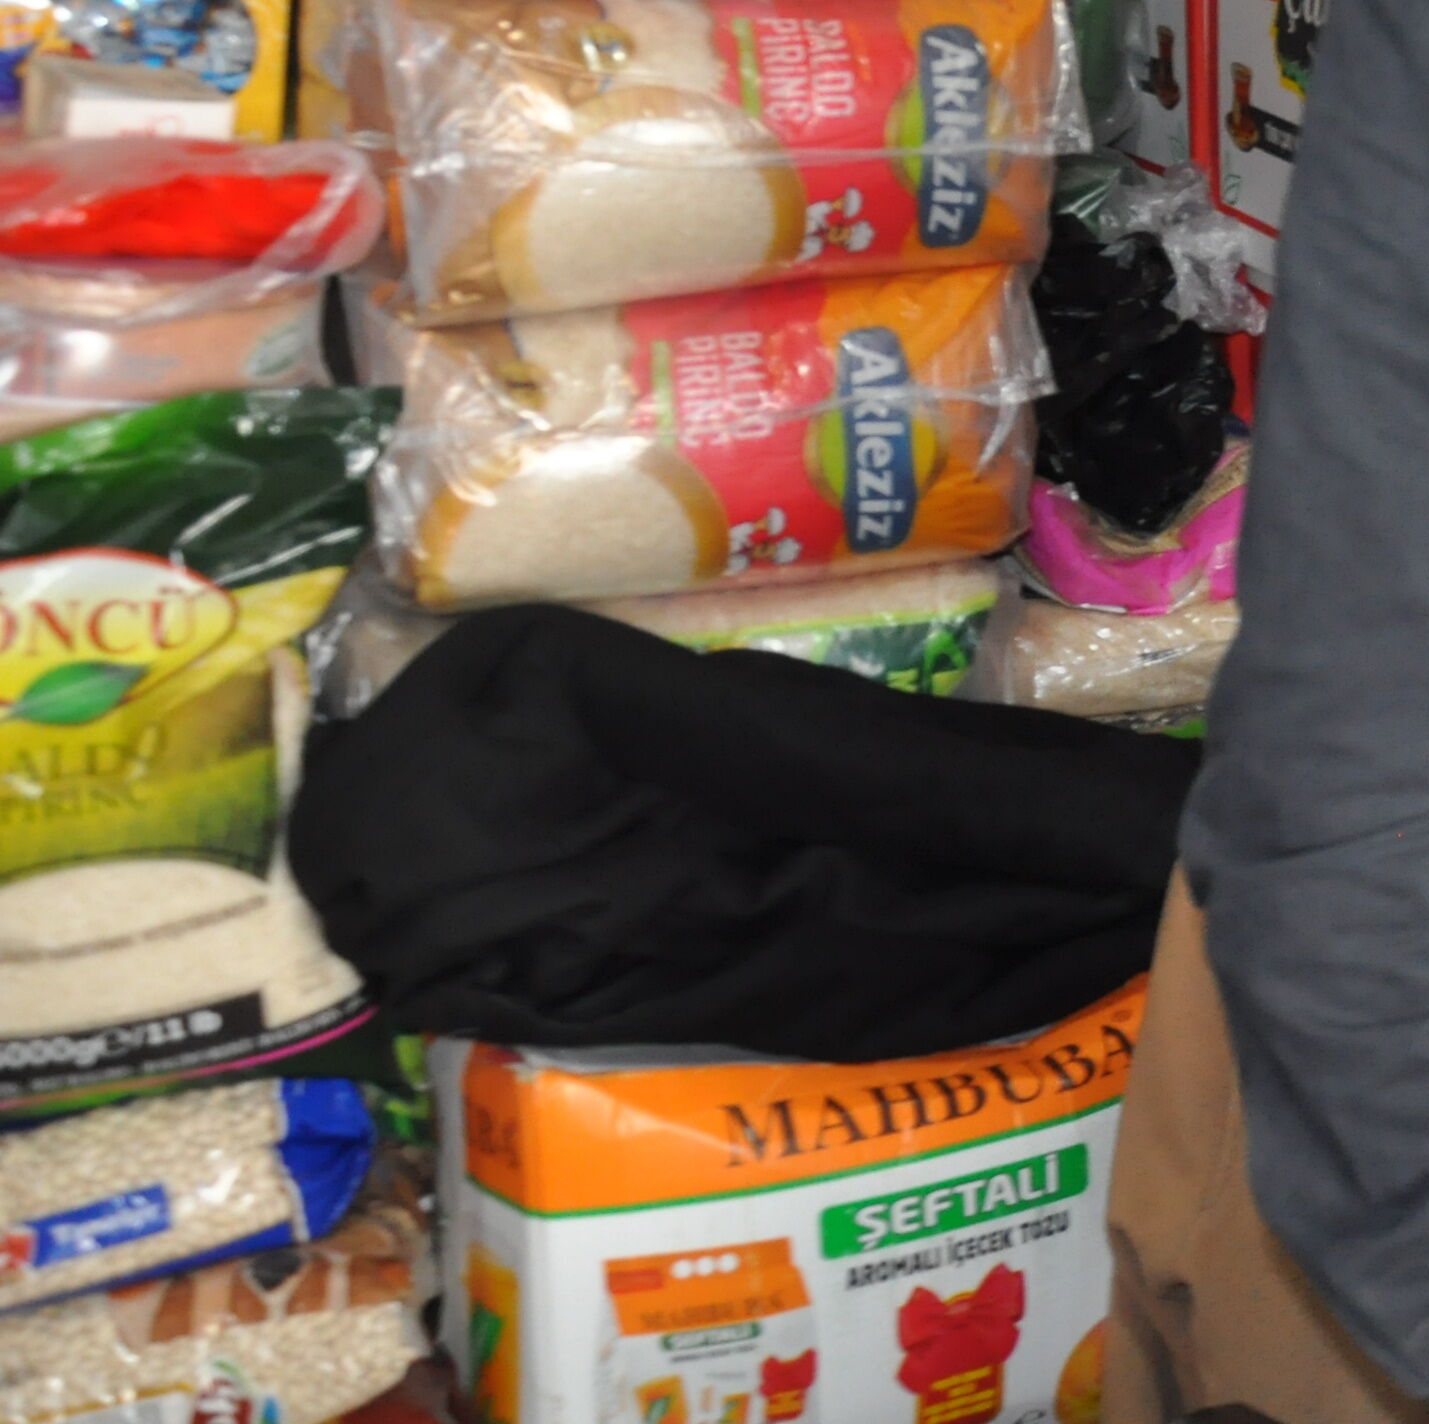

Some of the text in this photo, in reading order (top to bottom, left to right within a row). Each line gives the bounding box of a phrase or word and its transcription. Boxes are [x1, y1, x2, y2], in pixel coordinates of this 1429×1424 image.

[926, 36, 980, 235] Akleziz
[850, 341, 906, 544] Akleziz
[720, 1025, 1138, 1167] MAHBUBA
[845, 1210, 1070, 1291] AROMALI İÇECEK TOZU
[854, 1153, 1064, 1250] ŞEFTALİ
